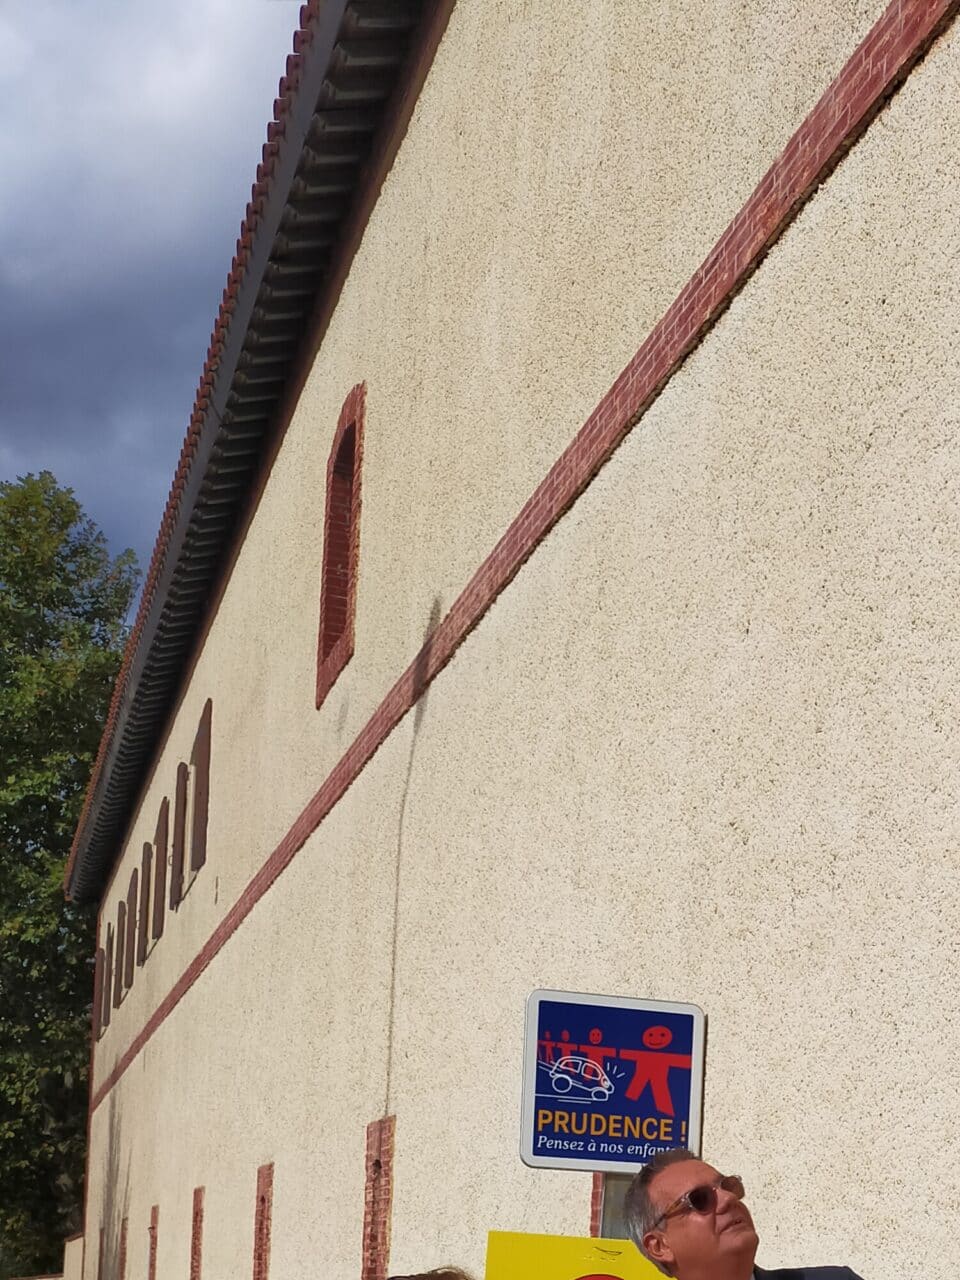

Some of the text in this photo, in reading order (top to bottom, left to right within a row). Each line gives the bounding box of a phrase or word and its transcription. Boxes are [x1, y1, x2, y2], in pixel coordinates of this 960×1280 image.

[537, 1109, 688, 1143] PRUDENCE !
[537, 1135, 585, 1151] Pensez
[587, 1139, 597, 1152] à
[600, 1144, 624, 1154] nos
[627, 1143, 676, 1158] enfan
